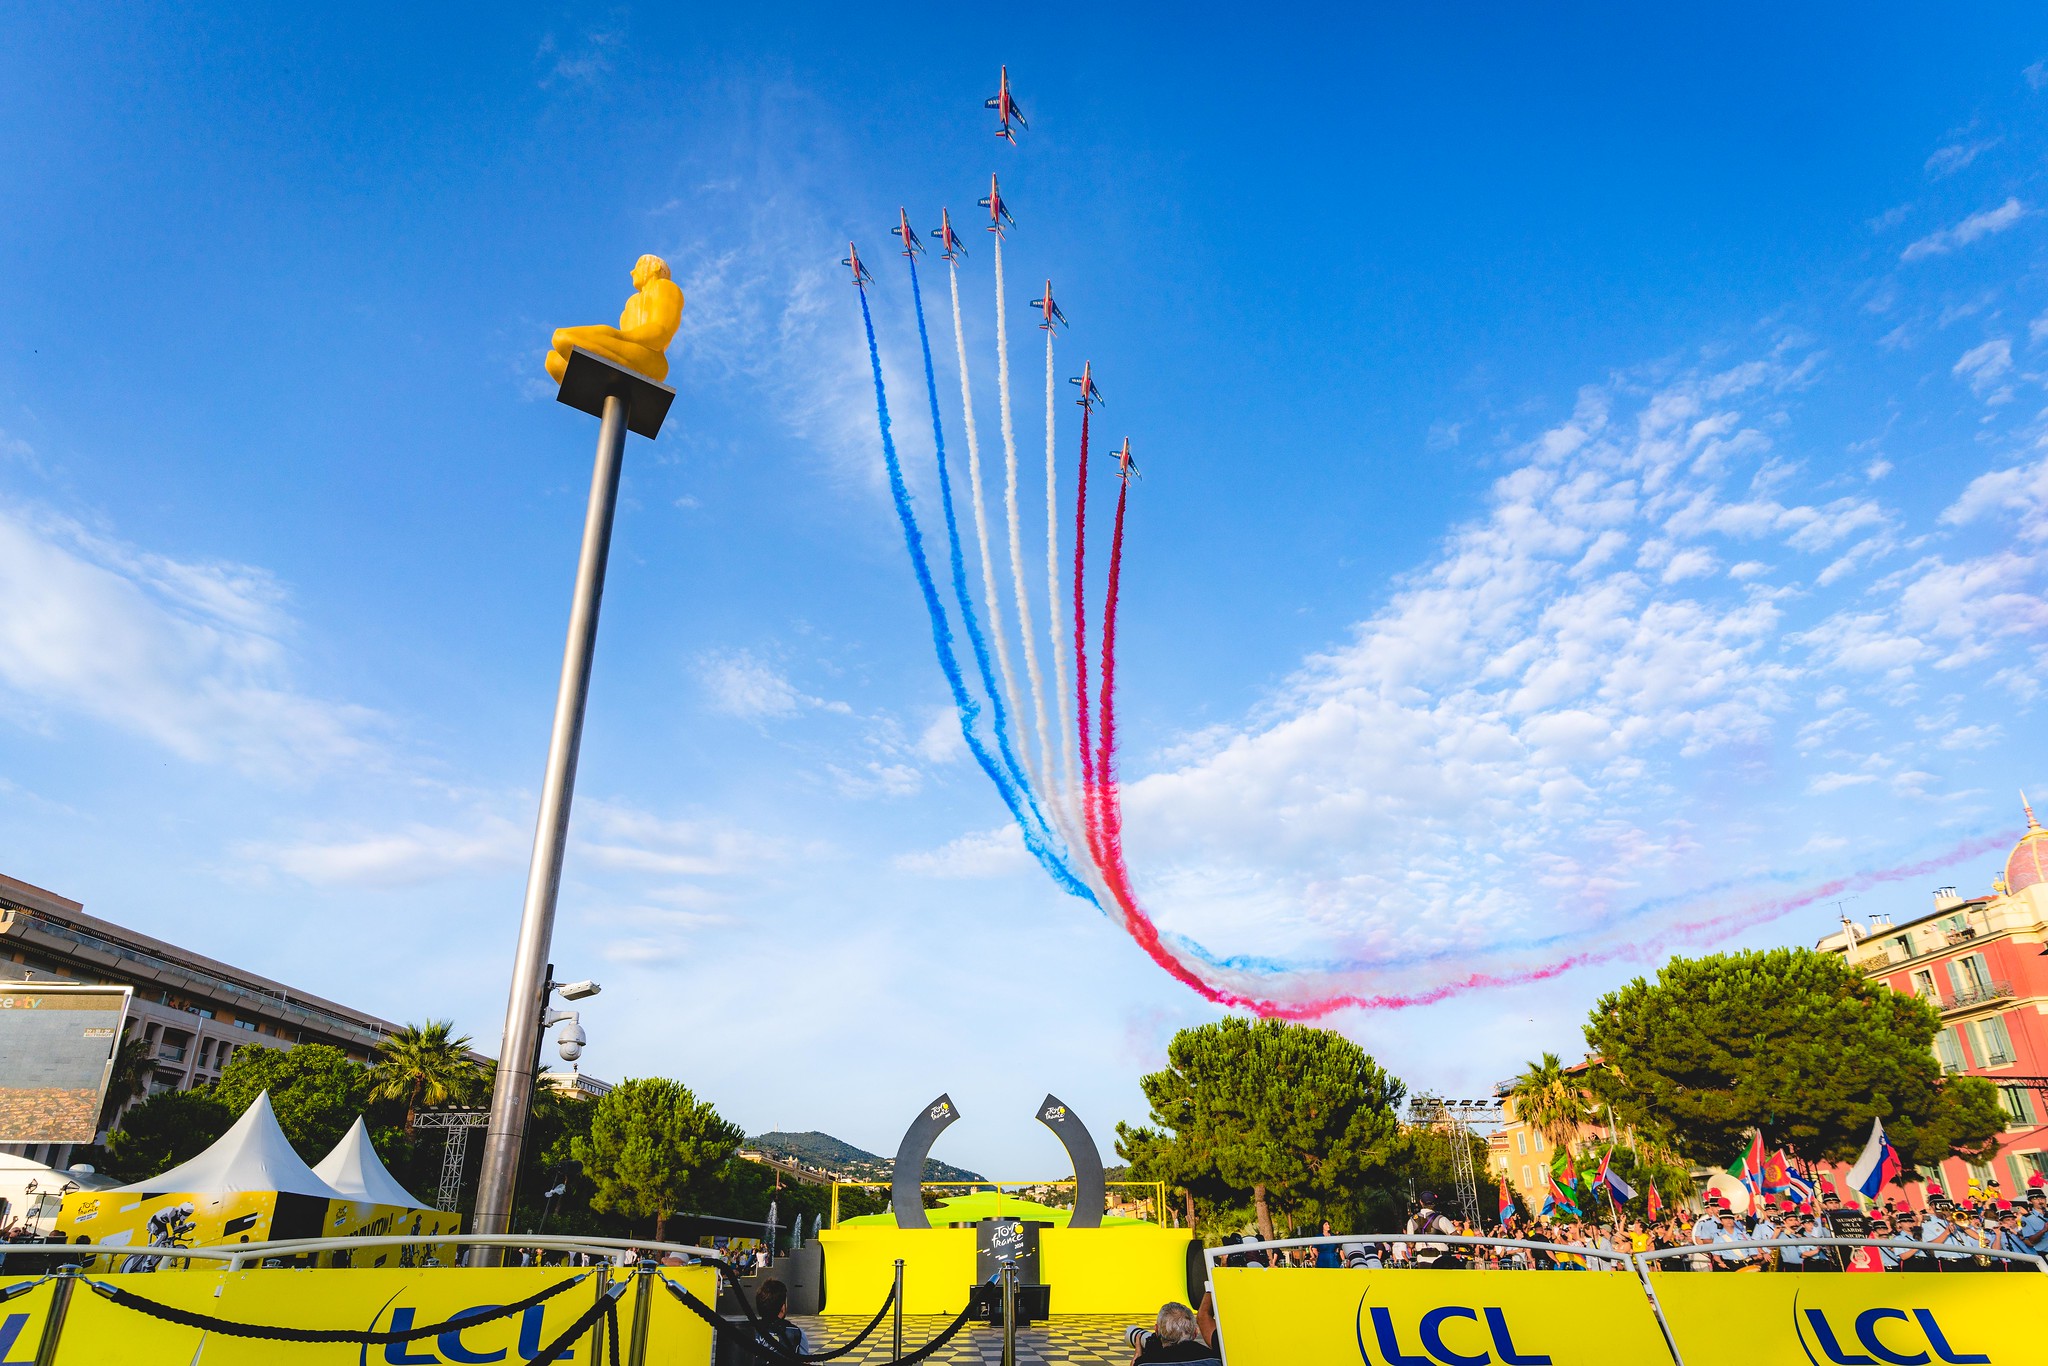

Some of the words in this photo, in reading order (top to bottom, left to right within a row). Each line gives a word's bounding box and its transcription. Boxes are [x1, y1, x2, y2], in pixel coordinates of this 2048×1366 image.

[384, 1304, 575, 1366] LCL
[1369, 1306, 1554, 1366] LCL
[1804, 1307, 1992, 1366] LCL
